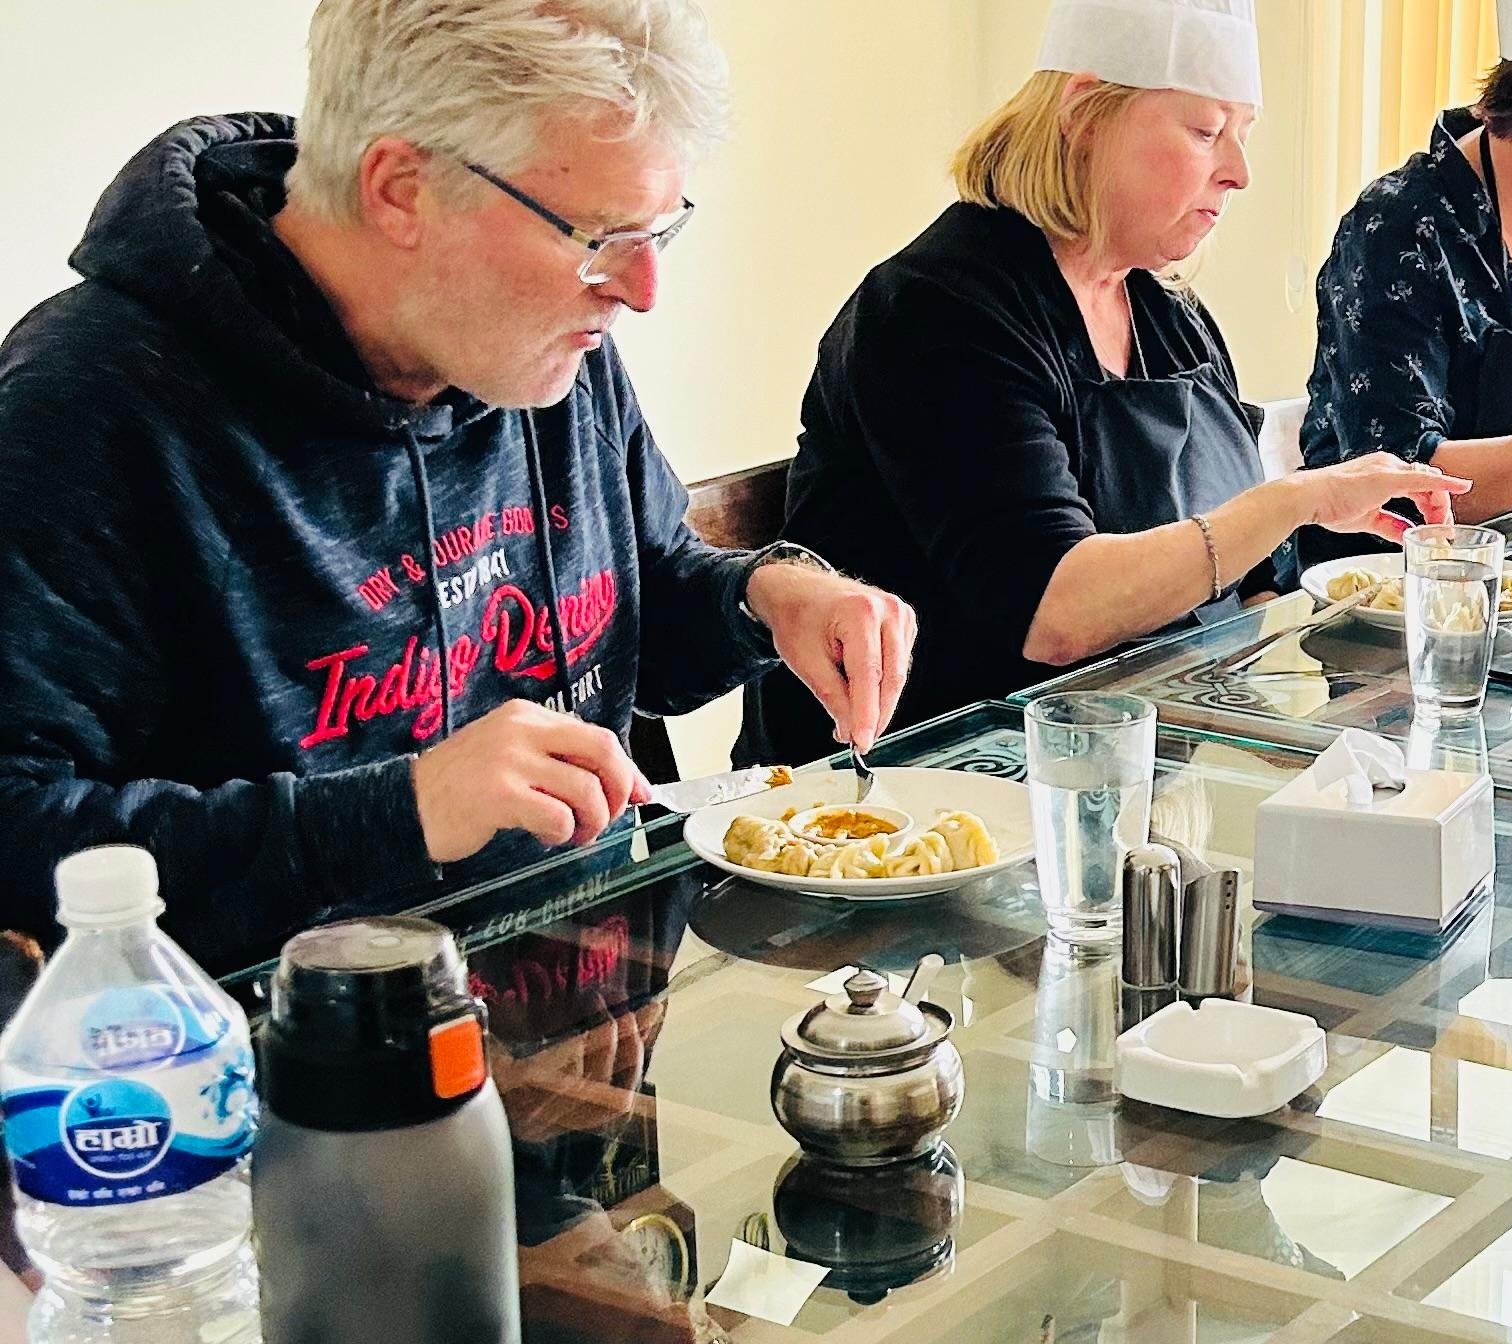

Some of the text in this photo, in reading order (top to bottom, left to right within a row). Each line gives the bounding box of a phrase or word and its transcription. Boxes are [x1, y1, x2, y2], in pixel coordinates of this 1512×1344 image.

[357, 566, 400, 611] DRY
[400, 553, 427, 583] &
[74, 1119, 162, 1154] हाम्रो
